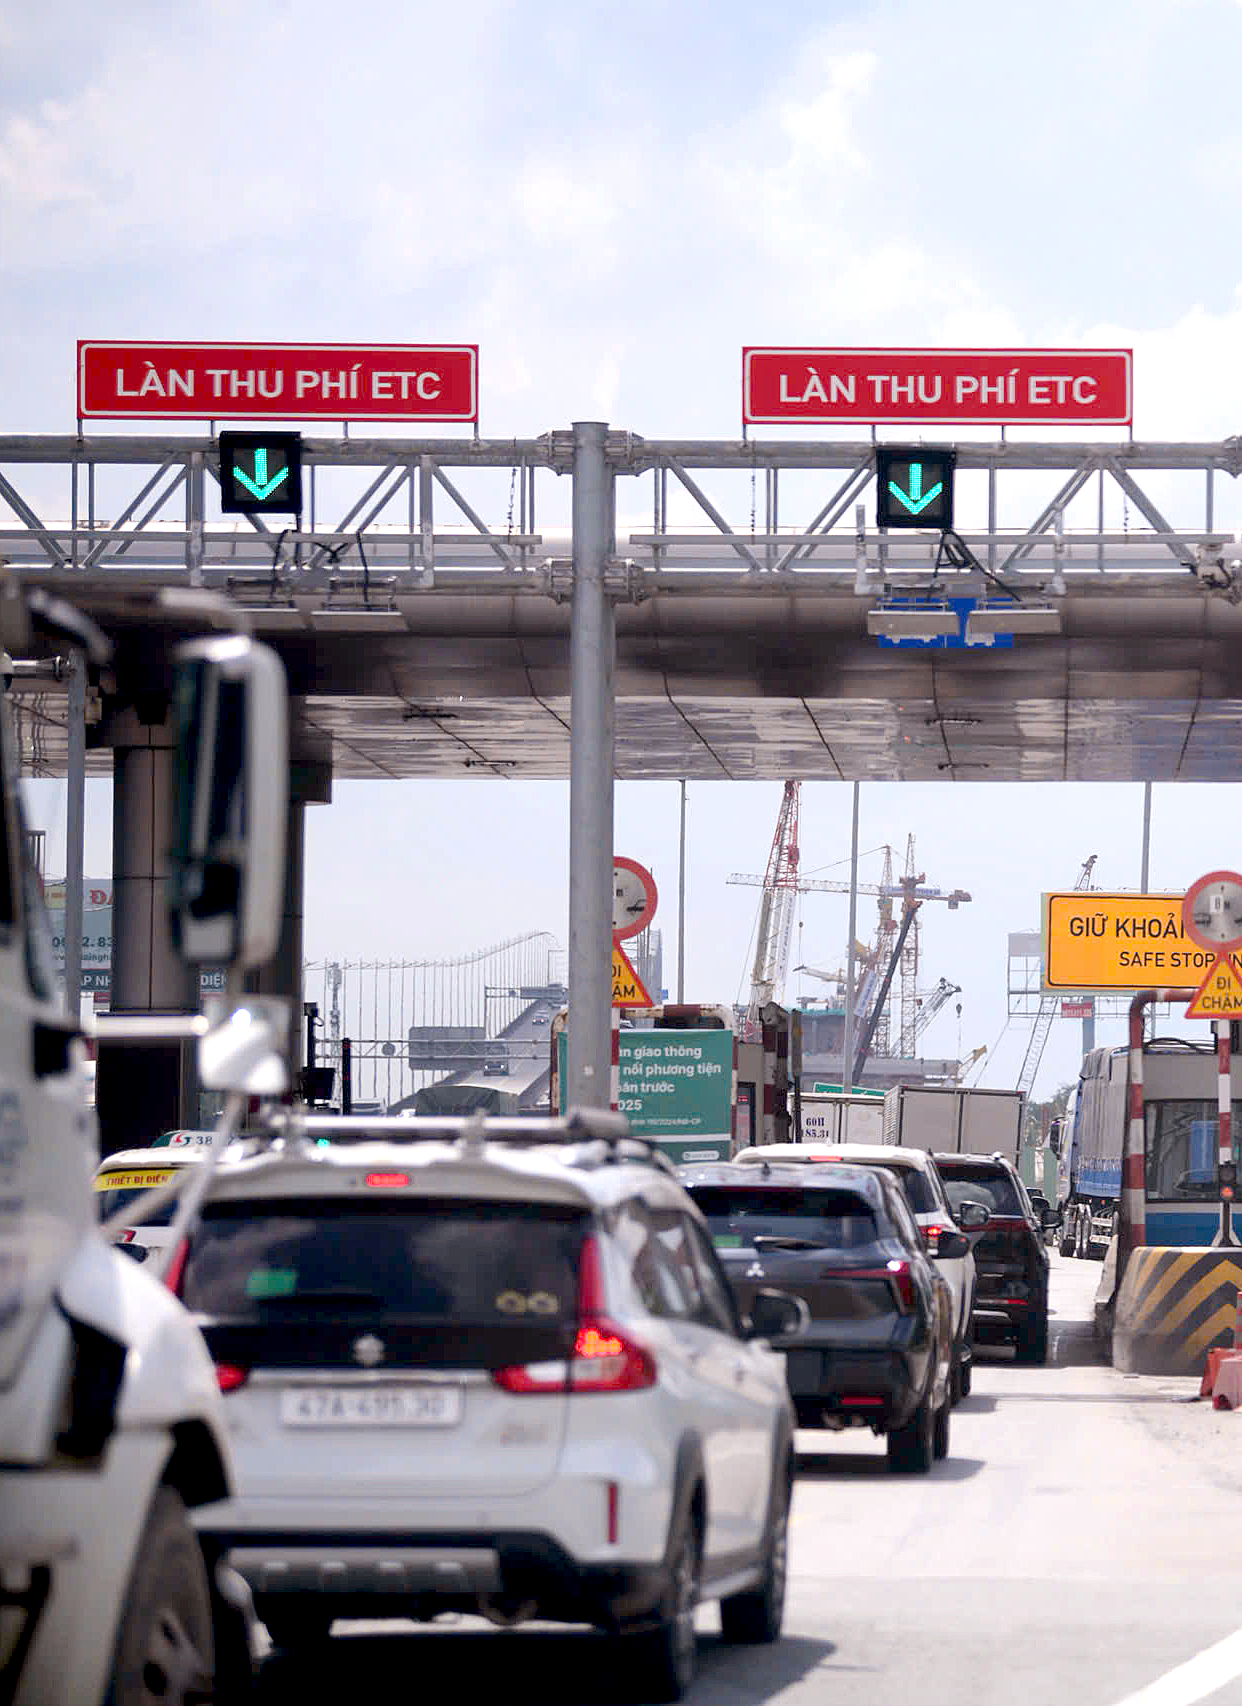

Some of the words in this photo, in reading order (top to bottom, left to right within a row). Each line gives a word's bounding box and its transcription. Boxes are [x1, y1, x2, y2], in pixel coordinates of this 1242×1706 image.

[116, 361, 194, 397] LÀN
[206, 369, 284, 398] THU
[296, 363, 362, 399] PHÍ
[372, 370, 442, 400] ETC
[780, 367, 855, 403] LÀN
[867, 375, 941, 403] THU
[956, 369, 1020, 404] PHÍ
[1029, 375, 1097, 404] ETC
[1069, 913, 1108, 937] GIỮ
[1115, 912, 1185, 939] KHOẢ
[1119, 951, 1165, 967] SAFE
[612, 981, 635, 1001] ẬM
[1216, 977, 1231, 990] ĐI
[634, 1047, 662, 1060] giao
[664, 1045, 702, 1060] thông
[623, 1061, 643, 1075] nối
[645, 1063, 695, 1077] phương
[697, 1062, 721, 1077] tiện
[641, 1081, 676, 1093] trước
